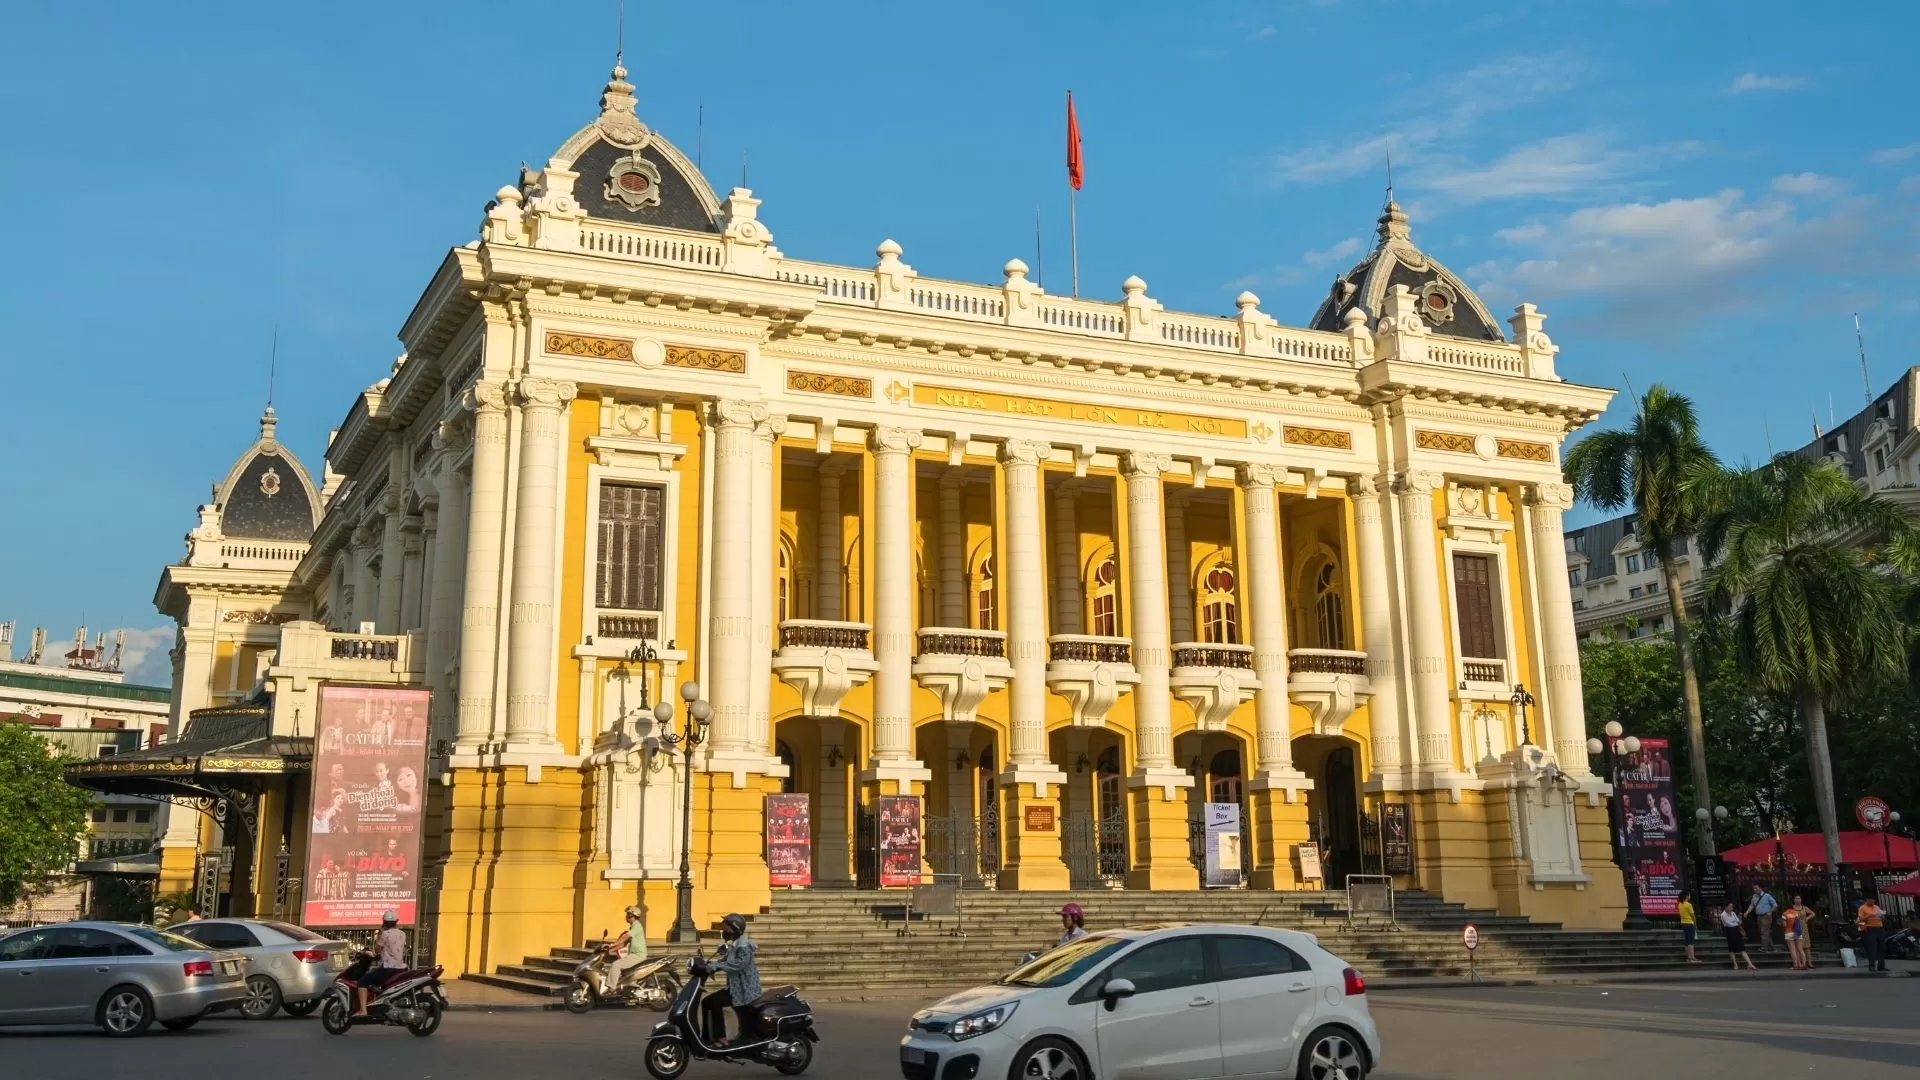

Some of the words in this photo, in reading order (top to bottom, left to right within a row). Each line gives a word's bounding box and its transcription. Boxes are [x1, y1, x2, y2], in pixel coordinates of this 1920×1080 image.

[936, 392, 986, 409] NHÀ
[1005, 399, 1053, 415] HÁT
[1137, 412, 1169, 428] HÀ
[1186, 418, 1225, 434] NỘI
